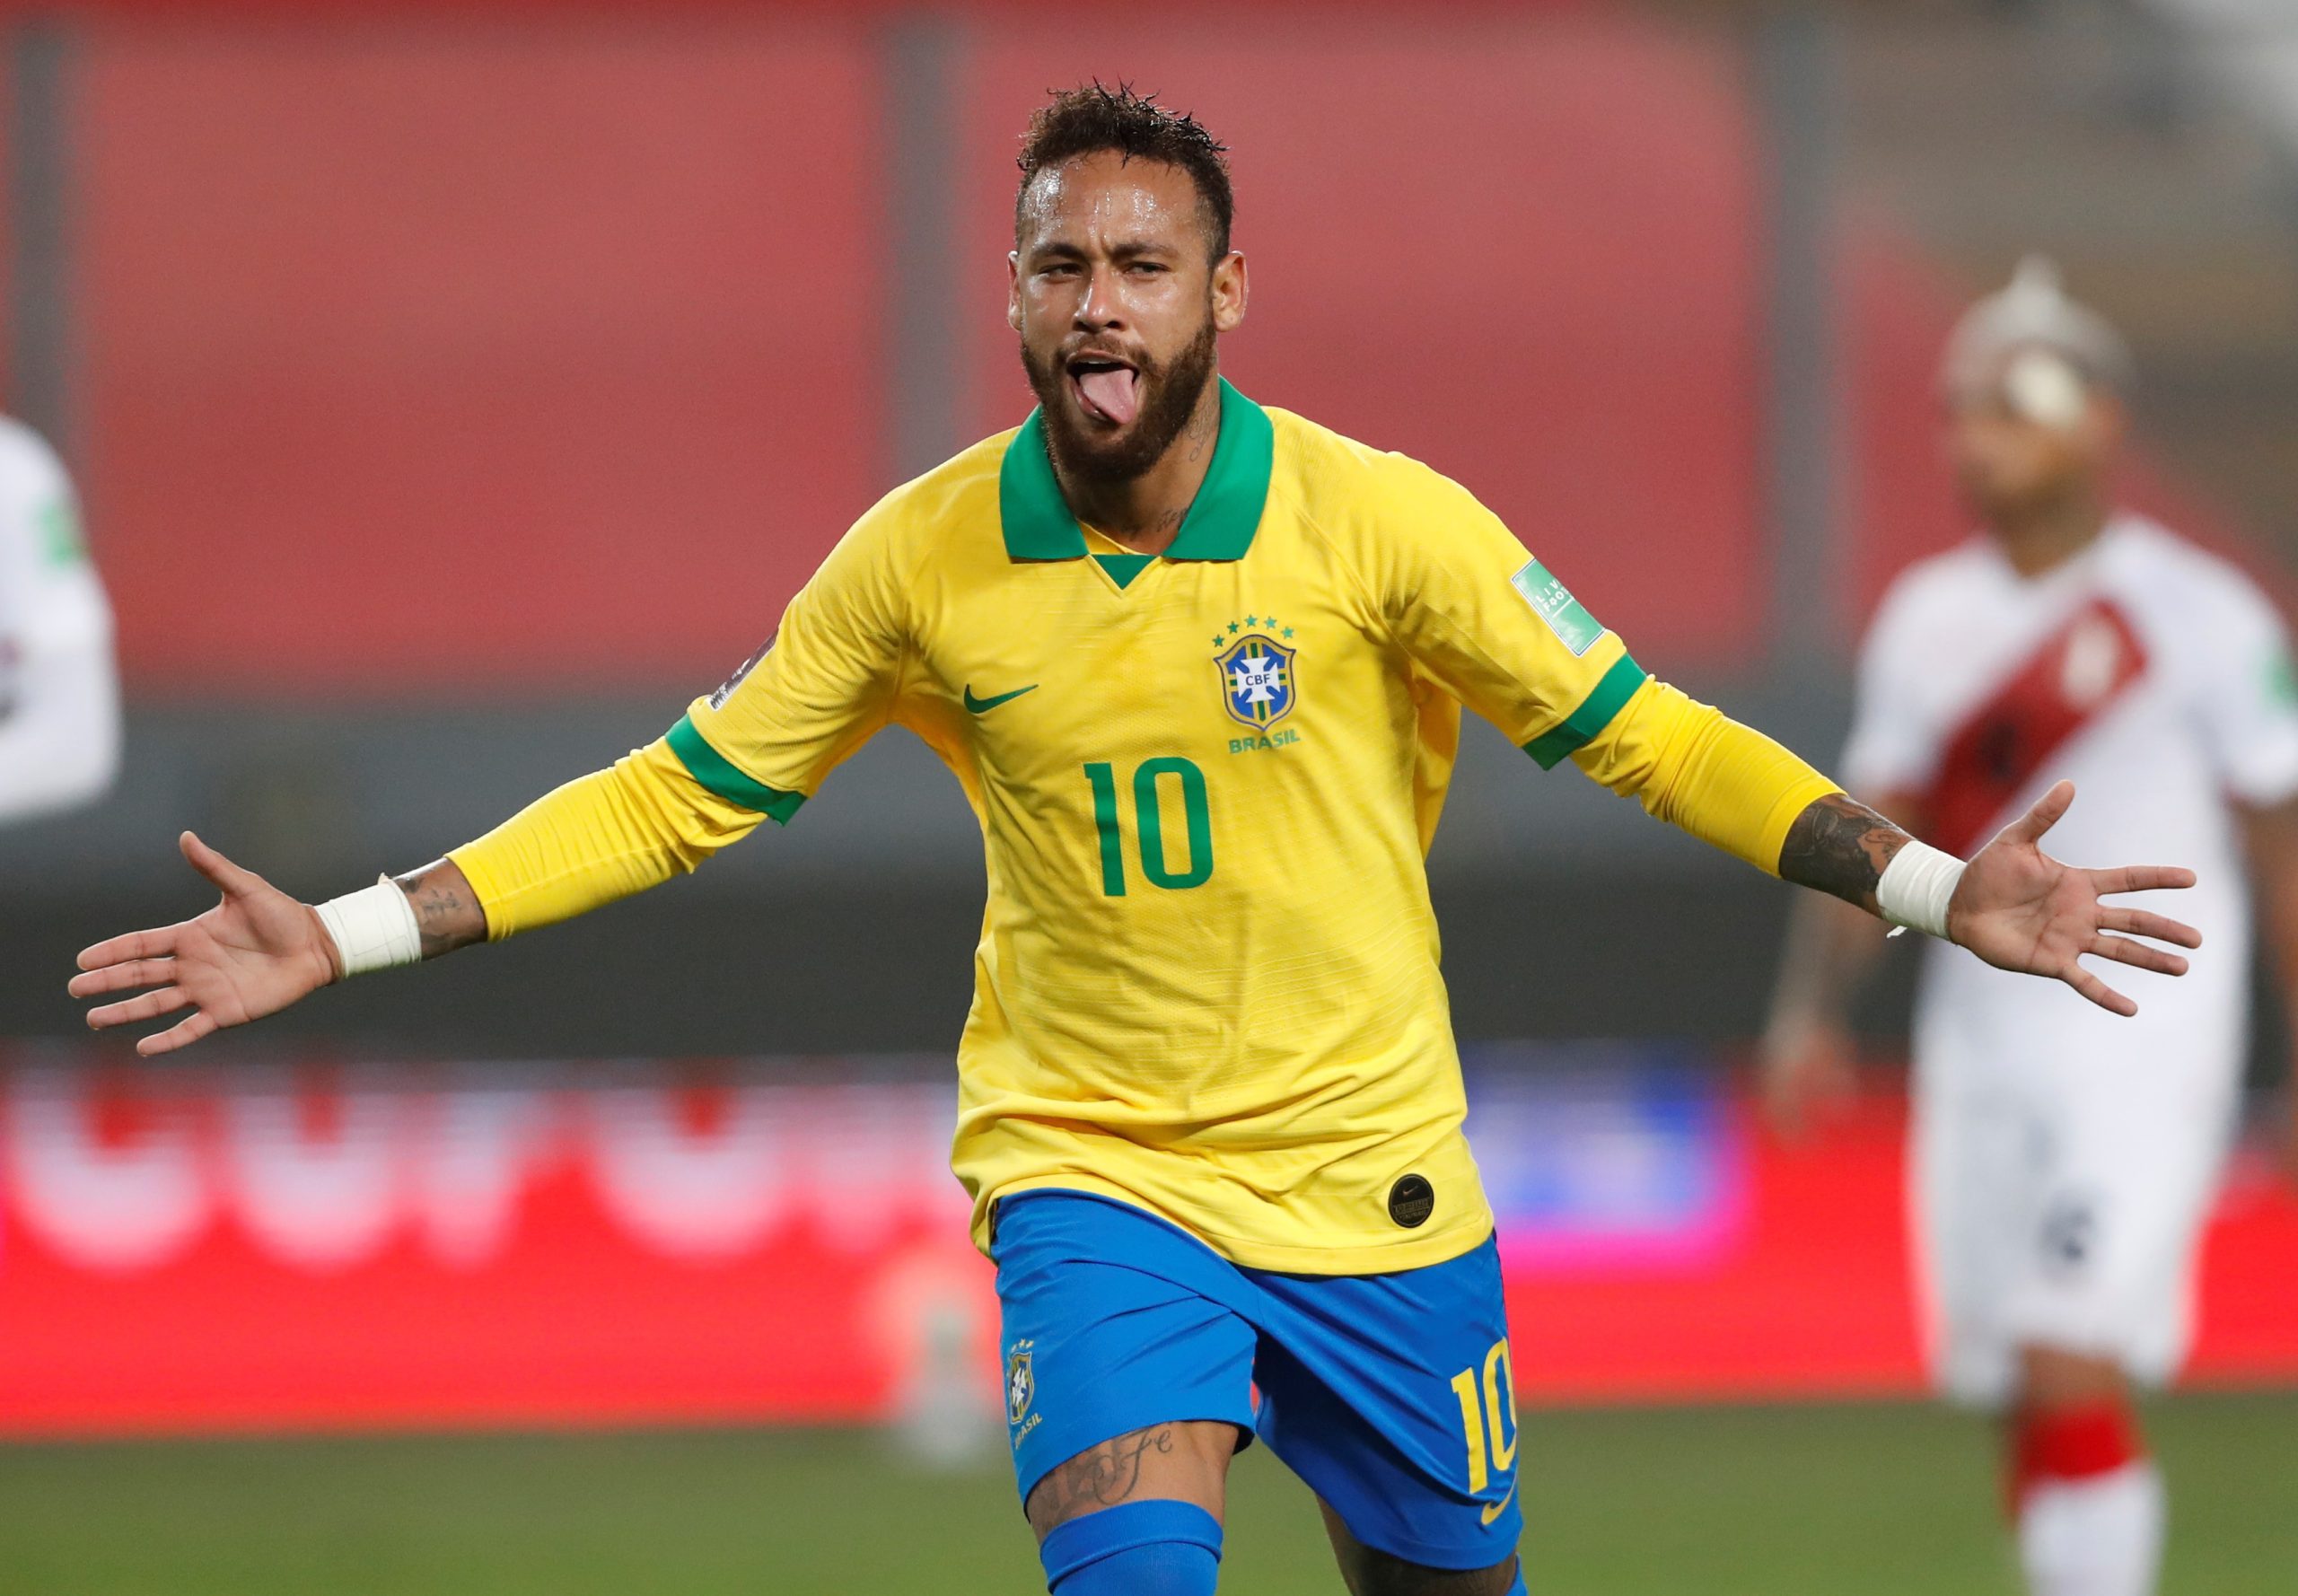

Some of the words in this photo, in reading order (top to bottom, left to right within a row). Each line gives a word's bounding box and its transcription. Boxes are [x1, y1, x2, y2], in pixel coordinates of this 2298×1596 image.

[1536, 579, 1559, 603] LIV
[1245, 673, 1271, 687] CBF
[1228, 729, 1301, 754] BRASIL
[1083, 756, 1215, 897] 10
[1451, 1336, 1517, 1495] 10
